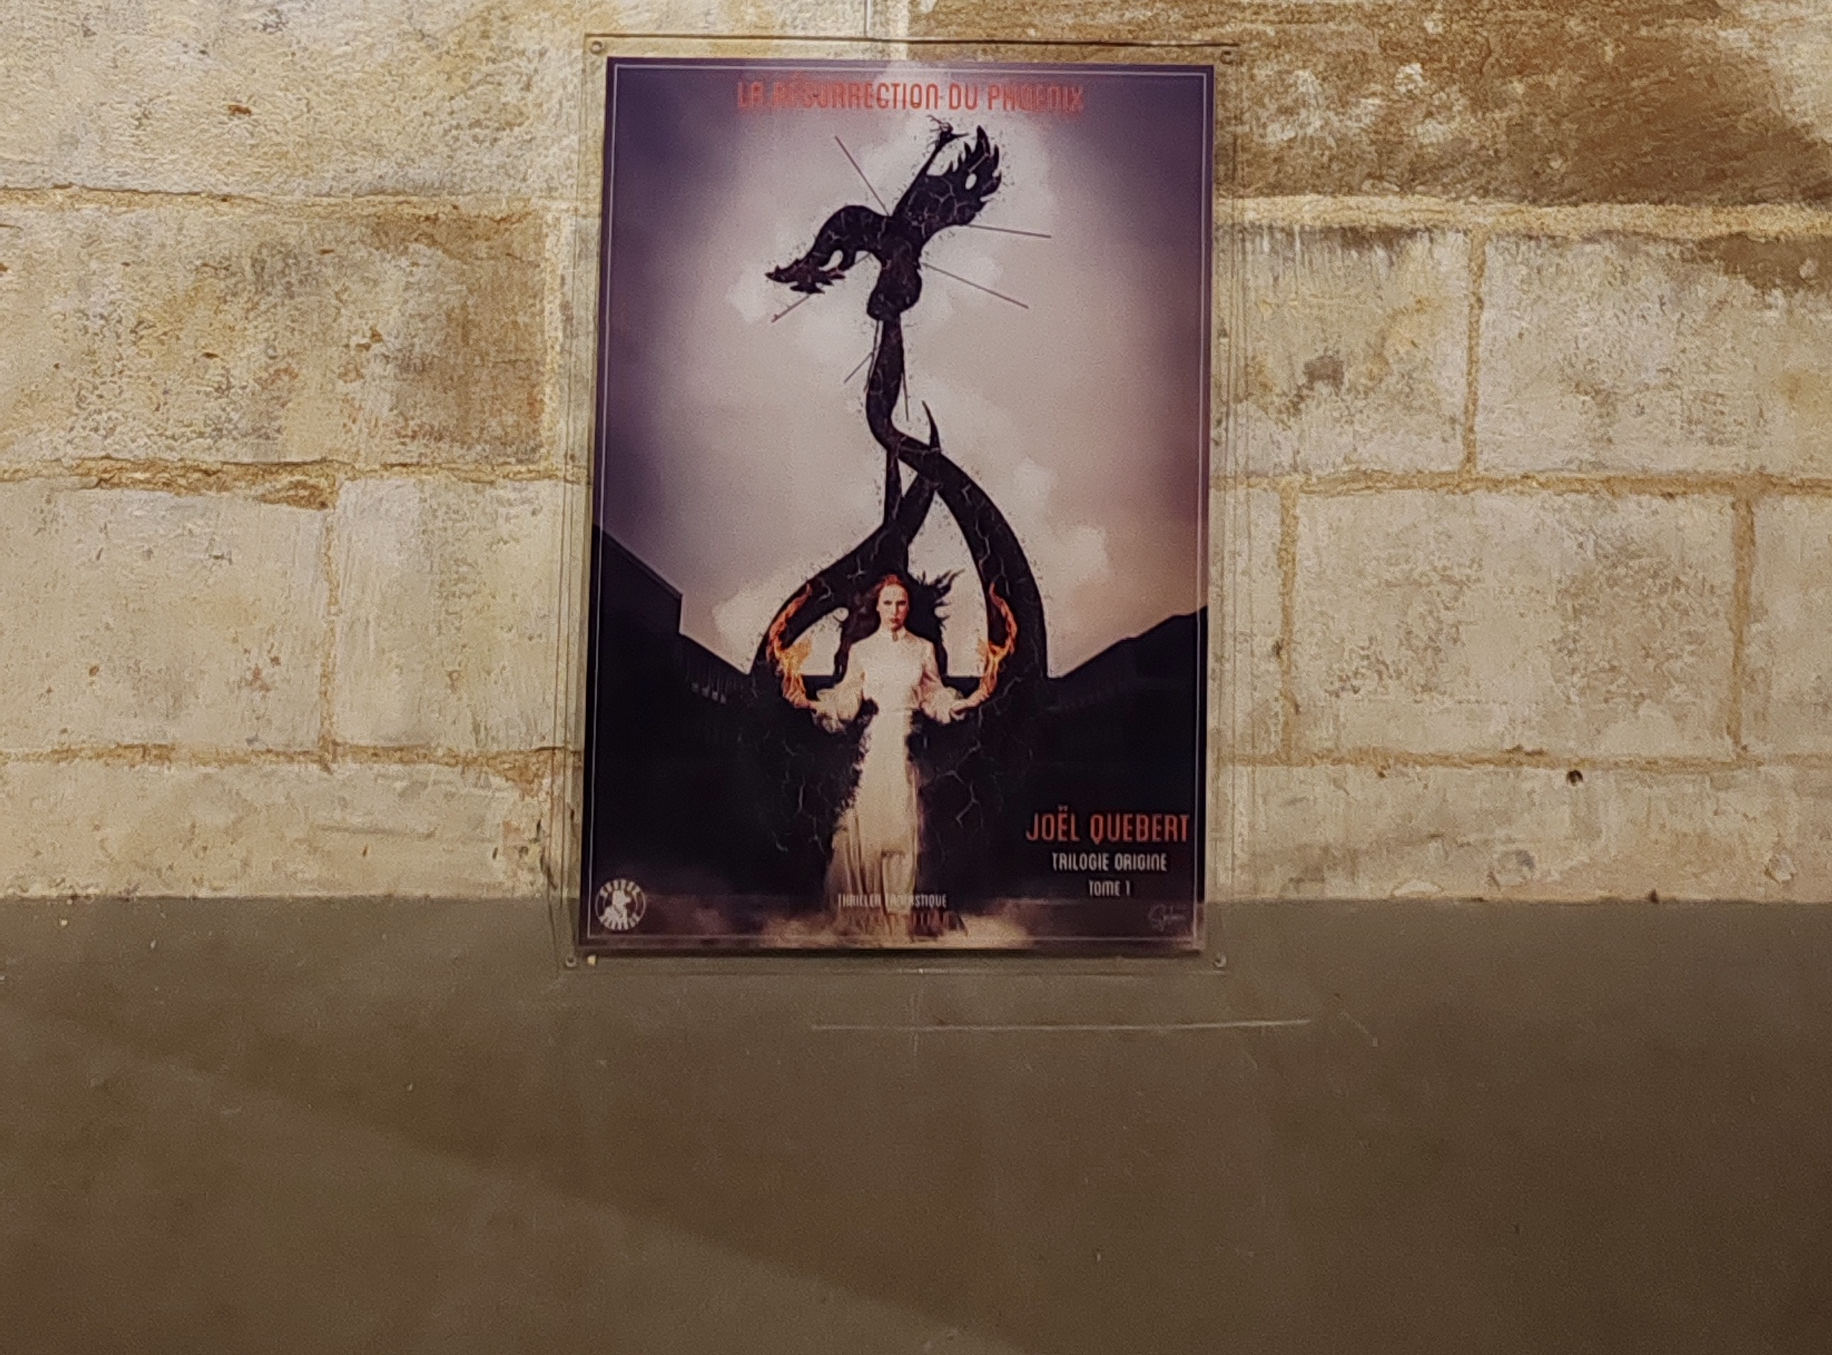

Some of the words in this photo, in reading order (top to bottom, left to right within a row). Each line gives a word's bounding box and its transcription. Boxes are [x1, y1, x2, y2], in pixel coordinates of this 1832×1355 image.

[737, 81, 764, 108] LA
[949, 82, 978, 110] DU
[1025, 805, 1080, 842] JOËL
[1090, 812, 1190, 845] QUEBERT
[1052, 852, 1110, 872] TRILOGIE
[1114, 852, 1167, 872] ORIGINE
[1088, 879, 1120, 897] TOME
[1126, 879, 1131, 897] 1
[886, 893, 948, 908] AASTIQUE
